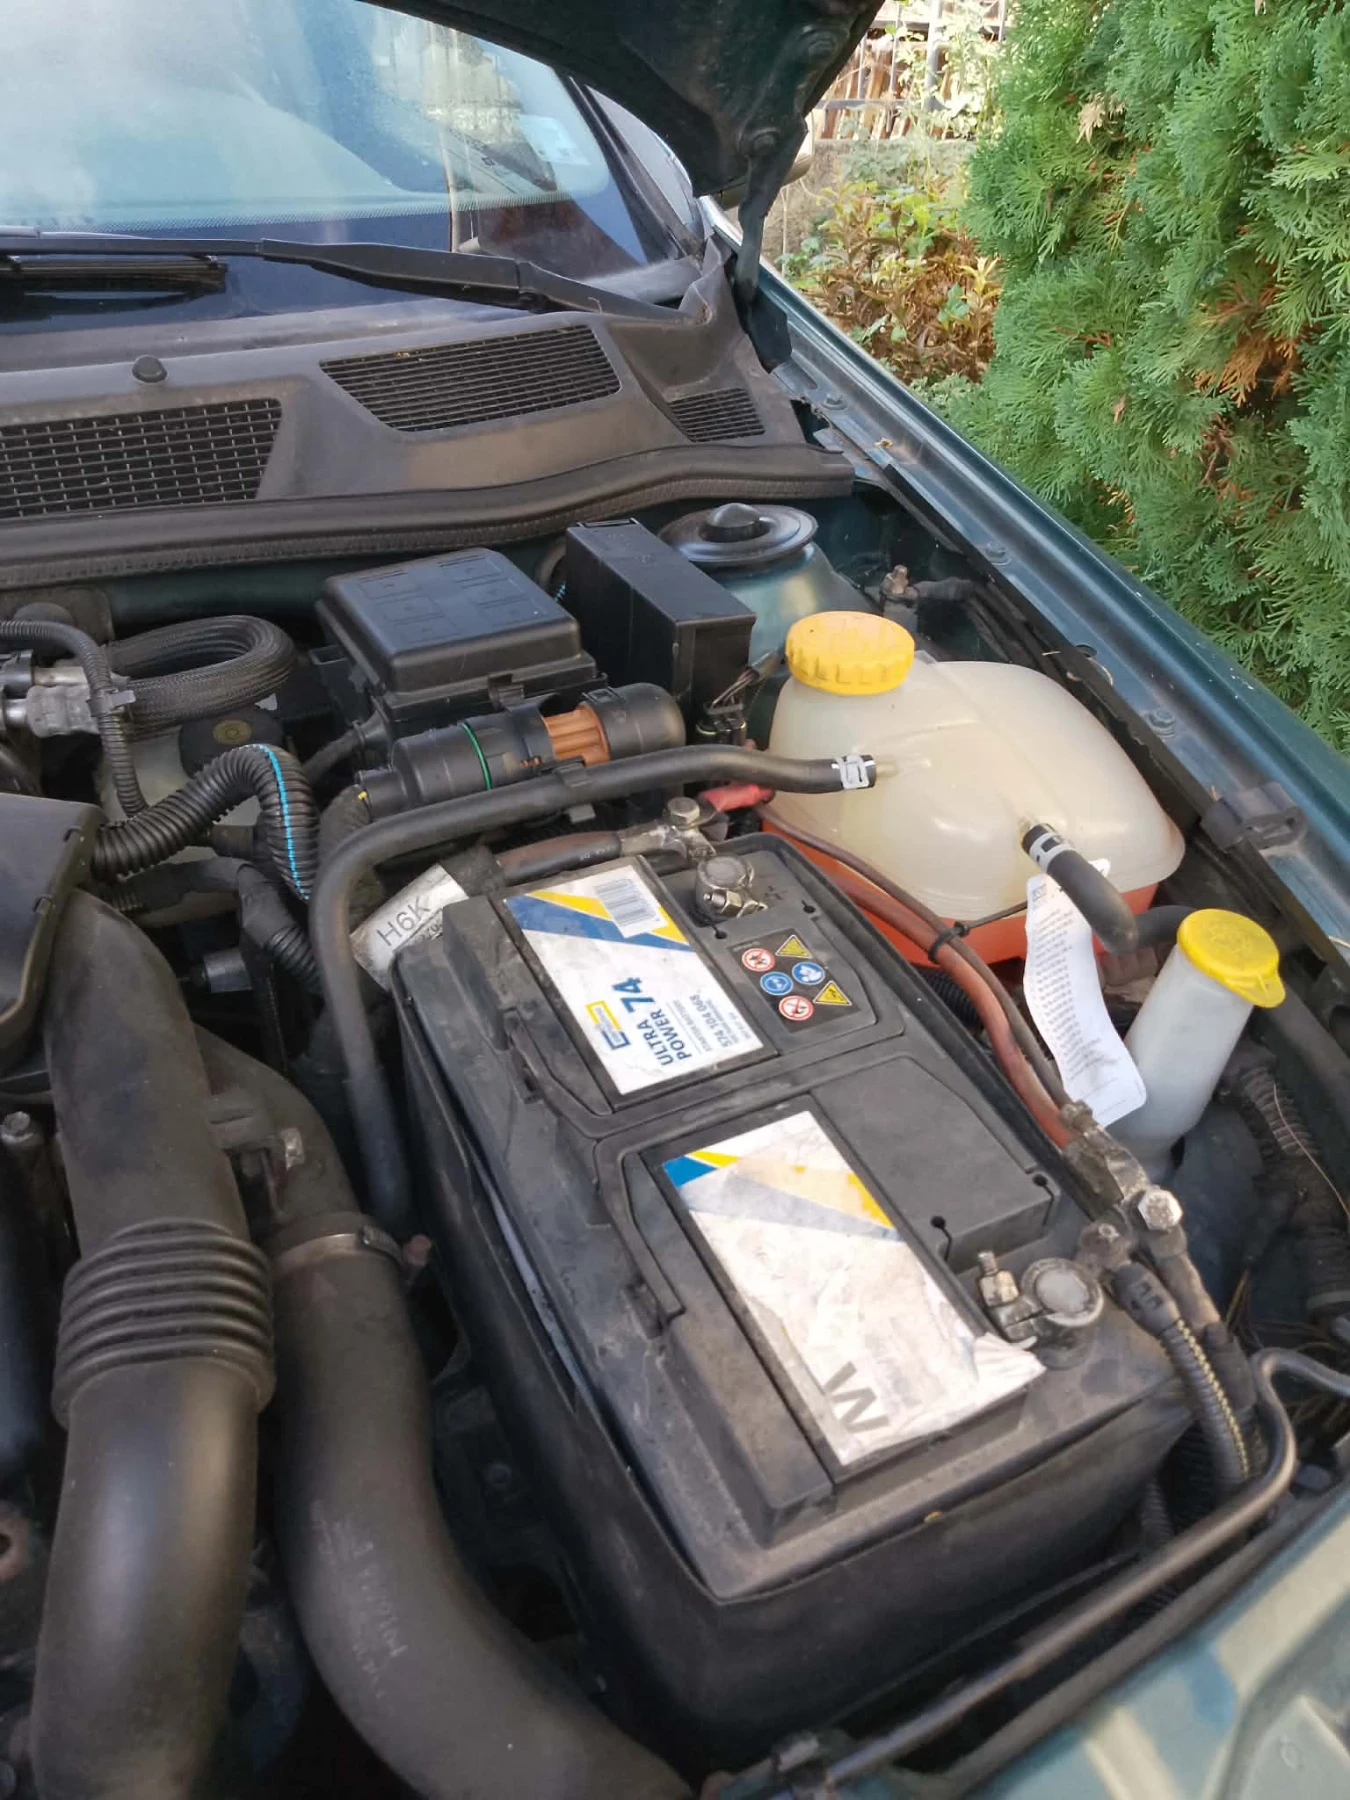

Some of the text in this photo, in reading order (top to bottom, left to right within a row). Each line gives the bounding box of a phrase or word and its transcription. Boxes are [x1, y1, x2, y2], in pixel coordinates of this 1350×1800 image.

[376, 896, 431, 946] H6K
[611, 976, 656, 1013] 74
[635, 1019, 675, 1066] ULTRA
[648, 1008, 692, 1060] POWER
